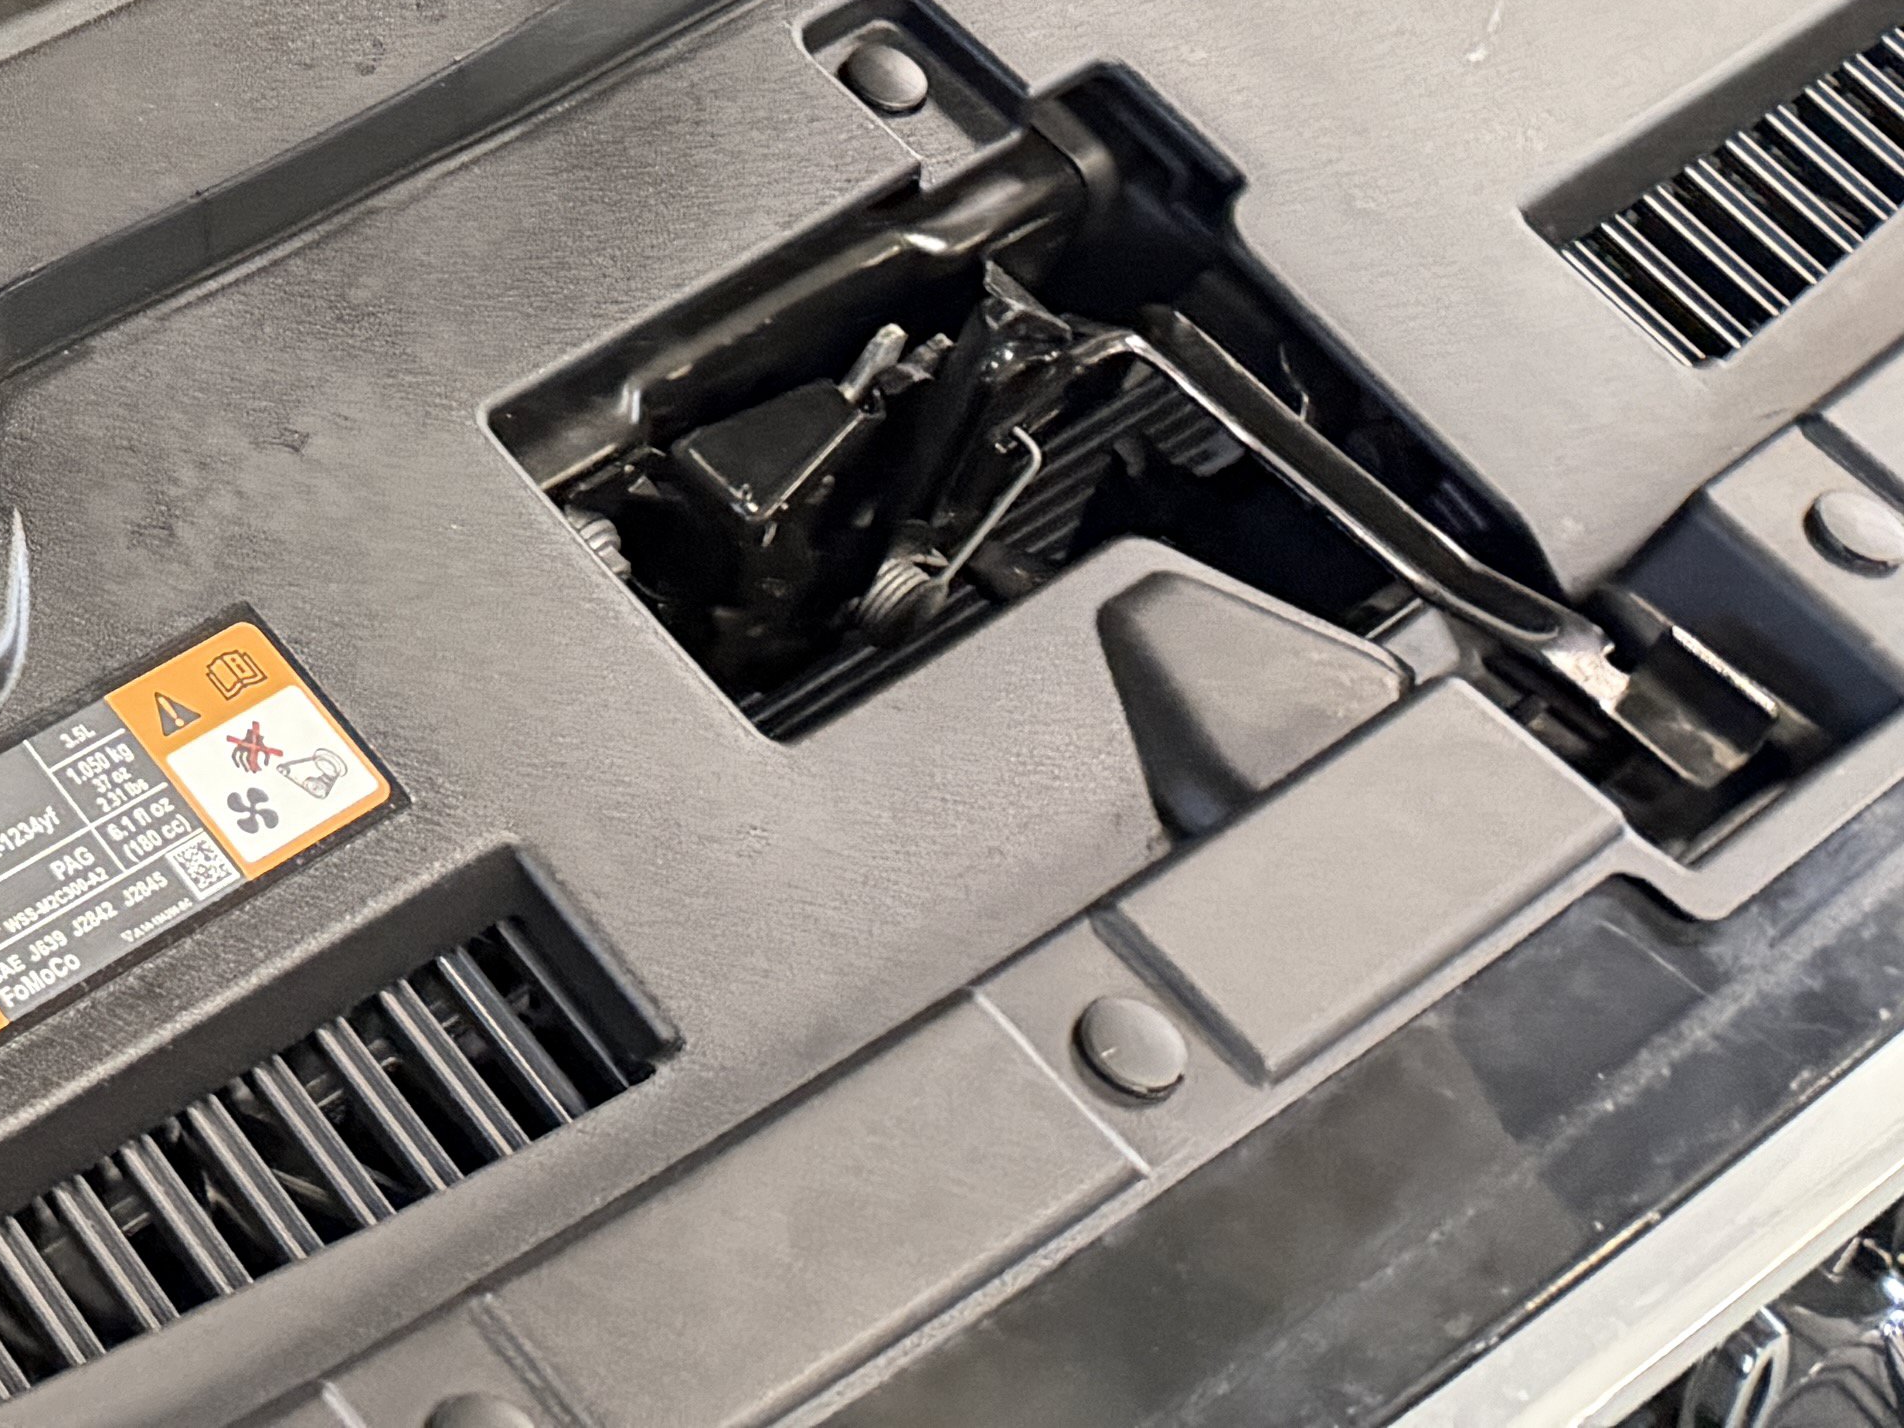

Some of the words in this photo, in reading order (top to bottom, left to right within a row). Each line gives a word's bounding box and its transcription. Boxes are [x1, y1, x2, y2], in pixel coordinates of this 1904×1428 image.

[60, 724, 95, 748] 3.5L
[66, 752, 110, 784] 1.050
[105, 744, 134, 769] kg
[92, 774, 111, 793] 37
[112, 767, 131, 783] oz
[96, 788, 129, 812] 2.31
[124, 779, 152, 800] lbs
[107, 816, 136, 841] 6.1
[133, 807, 151, 826] fl
[150, 798, 174, 817] oz
[123, 830, 162, 862] (180
[162, 814, 193, 839] cc)
[50, 847, 94, 880] PAG
[4, 871, 107, 933] WSS-M2C300-A2
[29, 930, 67, 961] J639
[72, 902, 118, 936] J2842
[123, 871, 167, 907] J2845
[0, 955, 79, 1007] FoMoCo
